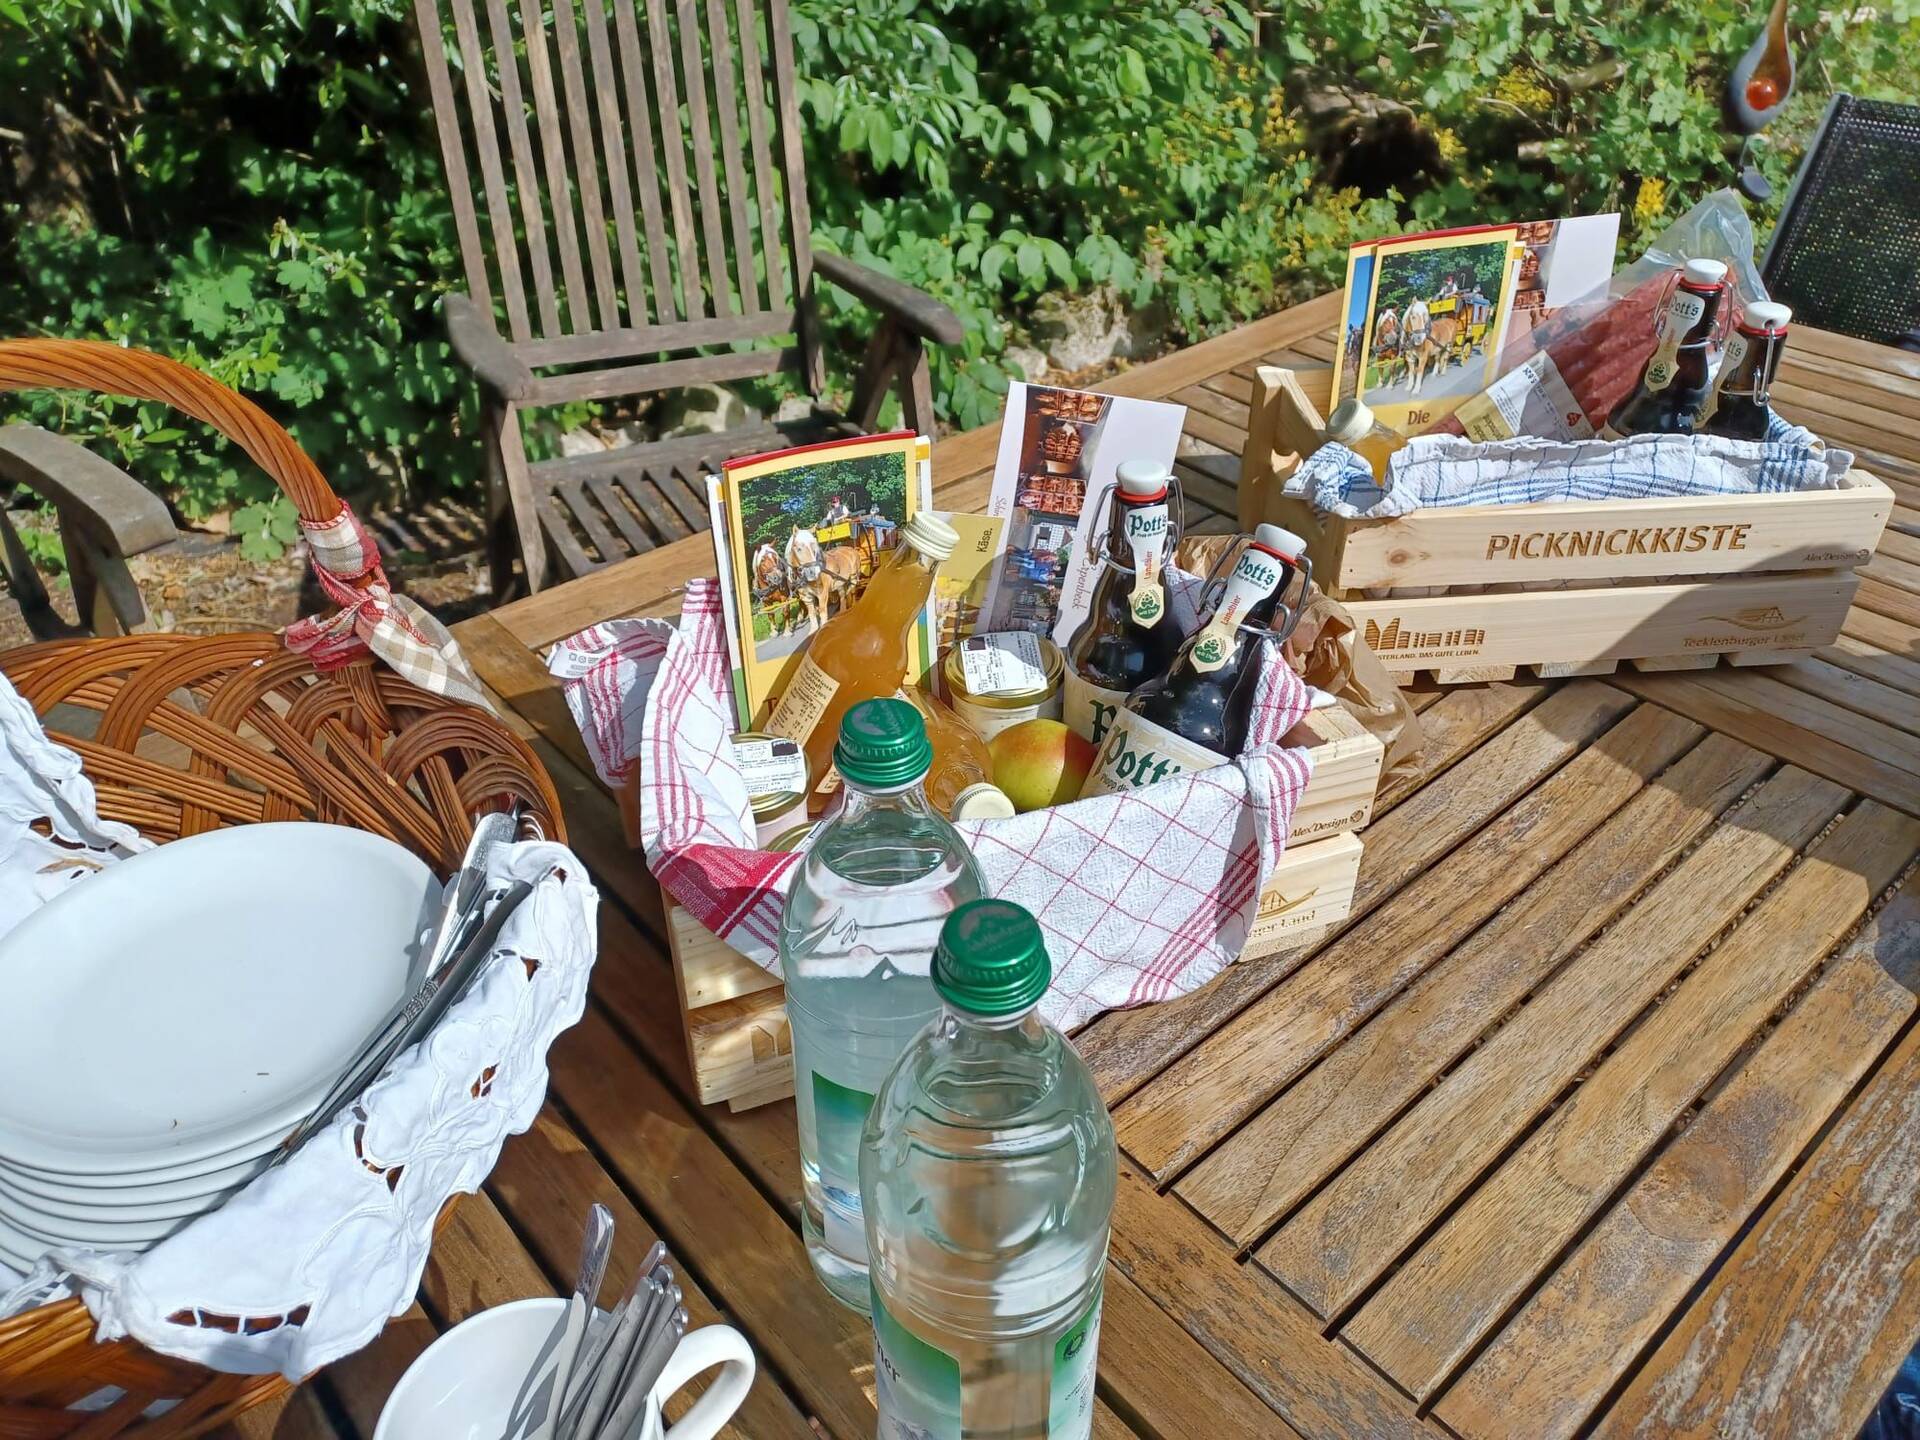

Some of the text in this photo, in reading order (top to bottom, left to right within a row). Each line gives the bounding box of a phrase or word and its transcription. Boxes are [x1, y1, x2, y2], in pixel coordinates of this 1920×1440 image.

[1408, 411, 1430, 425] Die
[976, 528, 993, 553] Käse.
[1486, 524, 1752, 560] PICKNICKKISTE
[1232, 554, 1275, 585] Pott's
[1377, 652, 1416, 660] STERLAND.
[1092, 726, 1181, 788] Pott'
